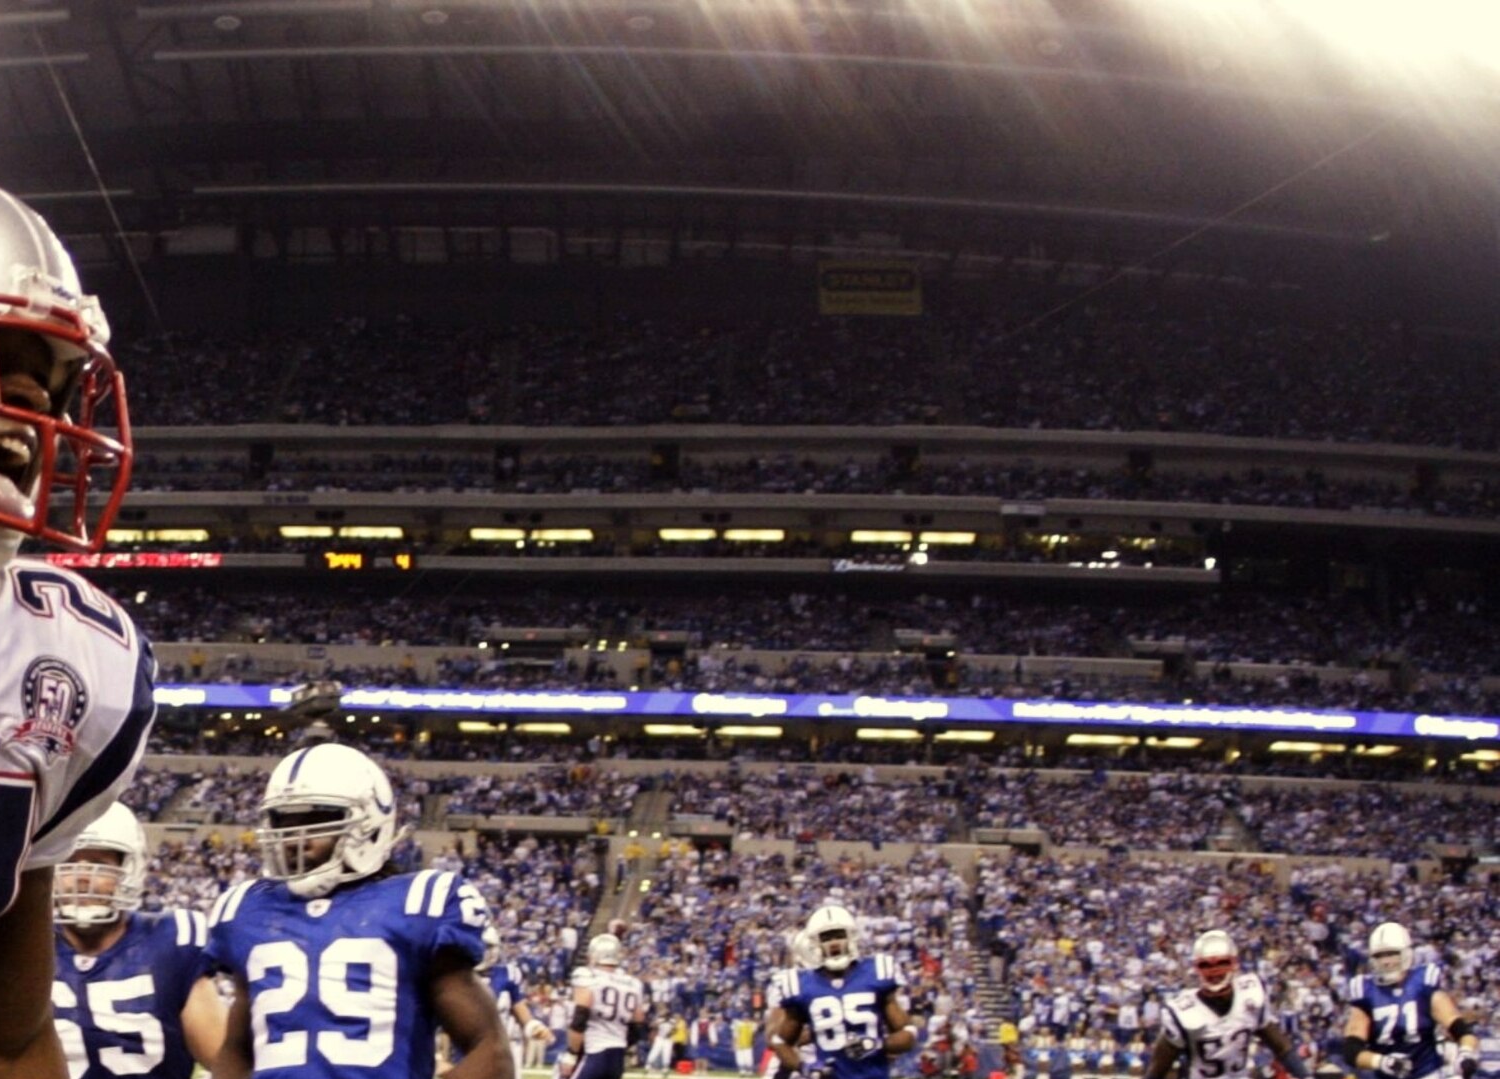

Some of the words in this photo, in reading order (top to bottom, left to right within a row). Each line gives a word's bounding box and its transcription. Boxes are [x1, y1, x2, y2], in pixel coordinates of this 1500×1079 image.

[246, 937, 398, 1072] 29
[596, 985, 638, 1025] 99
[809, 991, 878, 1052] 85
[1372, 1000, 1422, 1046] 71
[1196, 1028, 1252, 1078] 53
